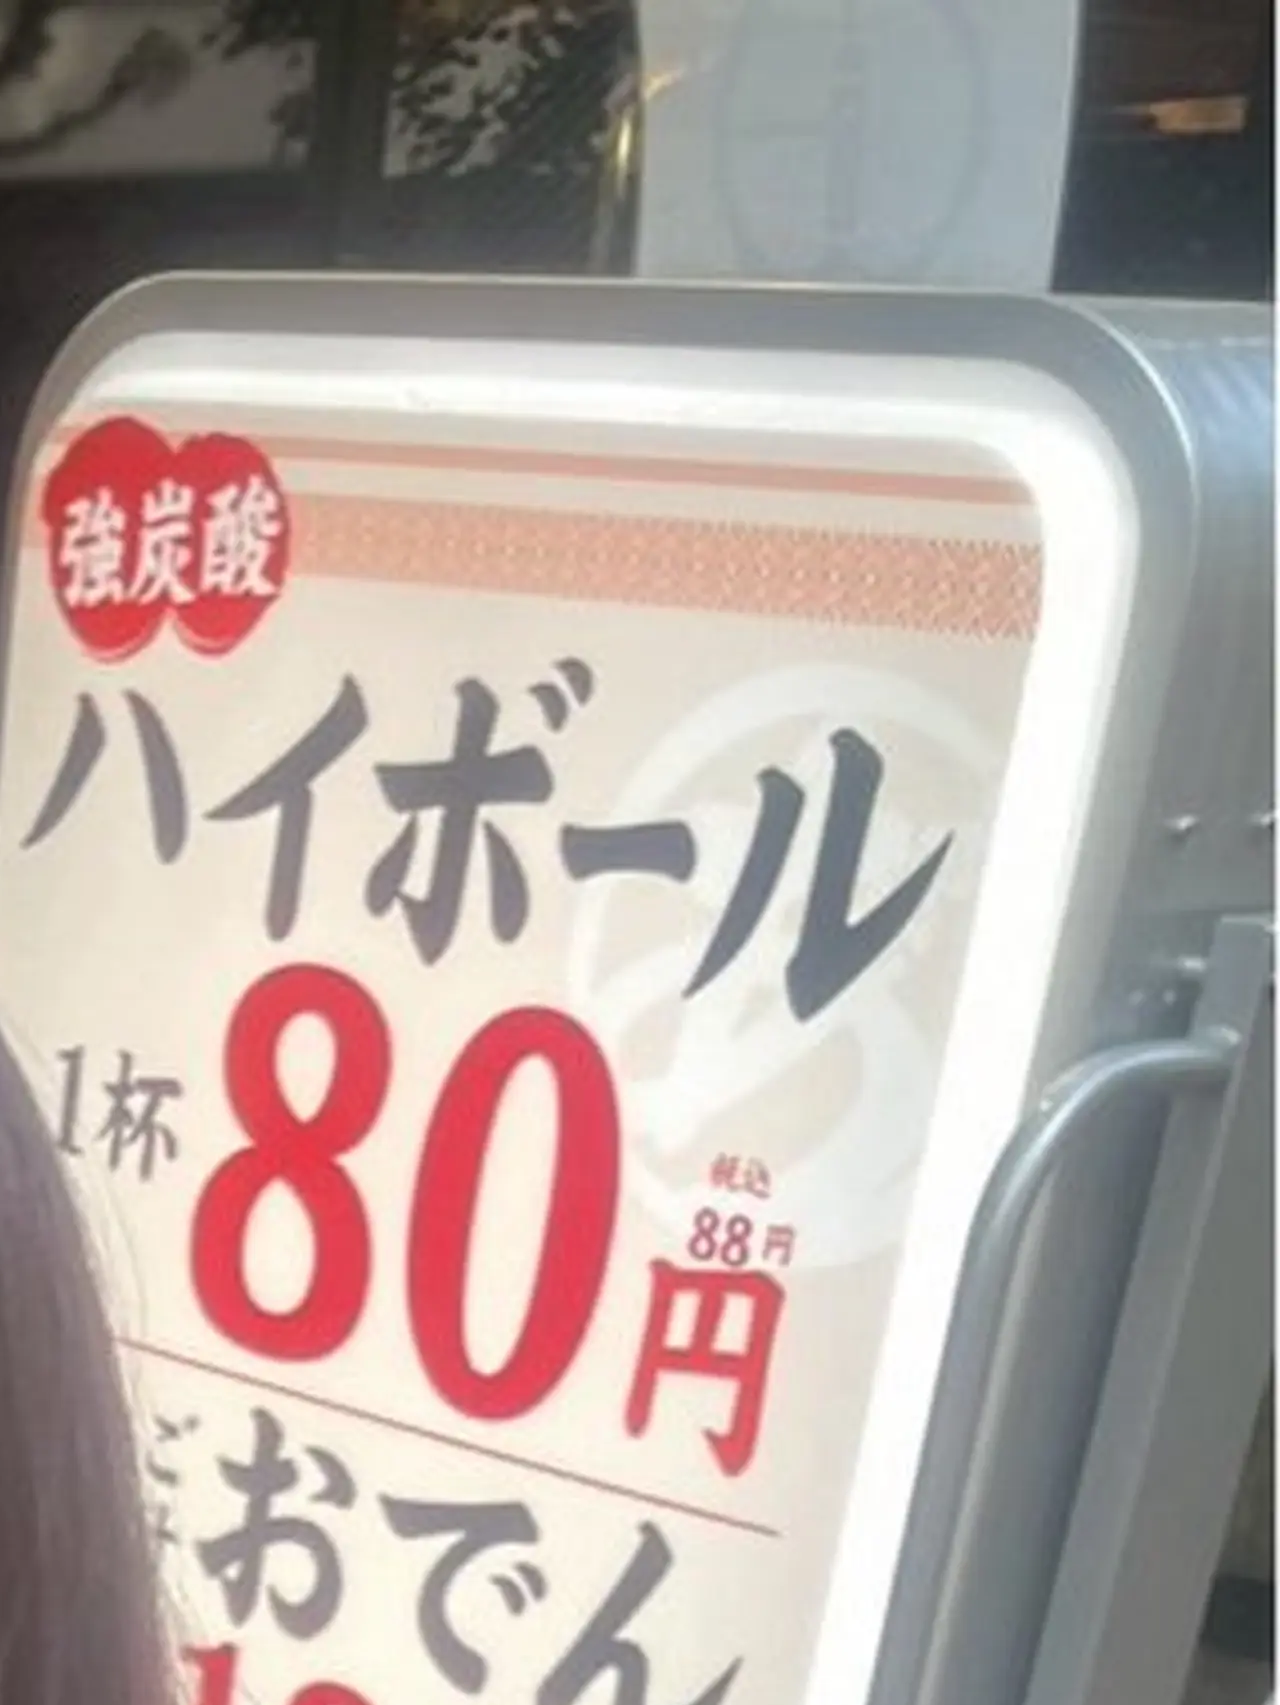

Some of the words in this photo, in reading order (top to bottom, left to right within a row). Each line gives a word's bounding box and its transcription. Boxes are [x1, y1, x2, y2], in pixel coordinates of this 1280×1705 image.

[60, 476, 286, 608] 強炭酸
[22, 656, 956, 1024] ハイボール
[56, 1044, 184, 1184] 1杯
[688, 1206, 797, 1267] 88円
